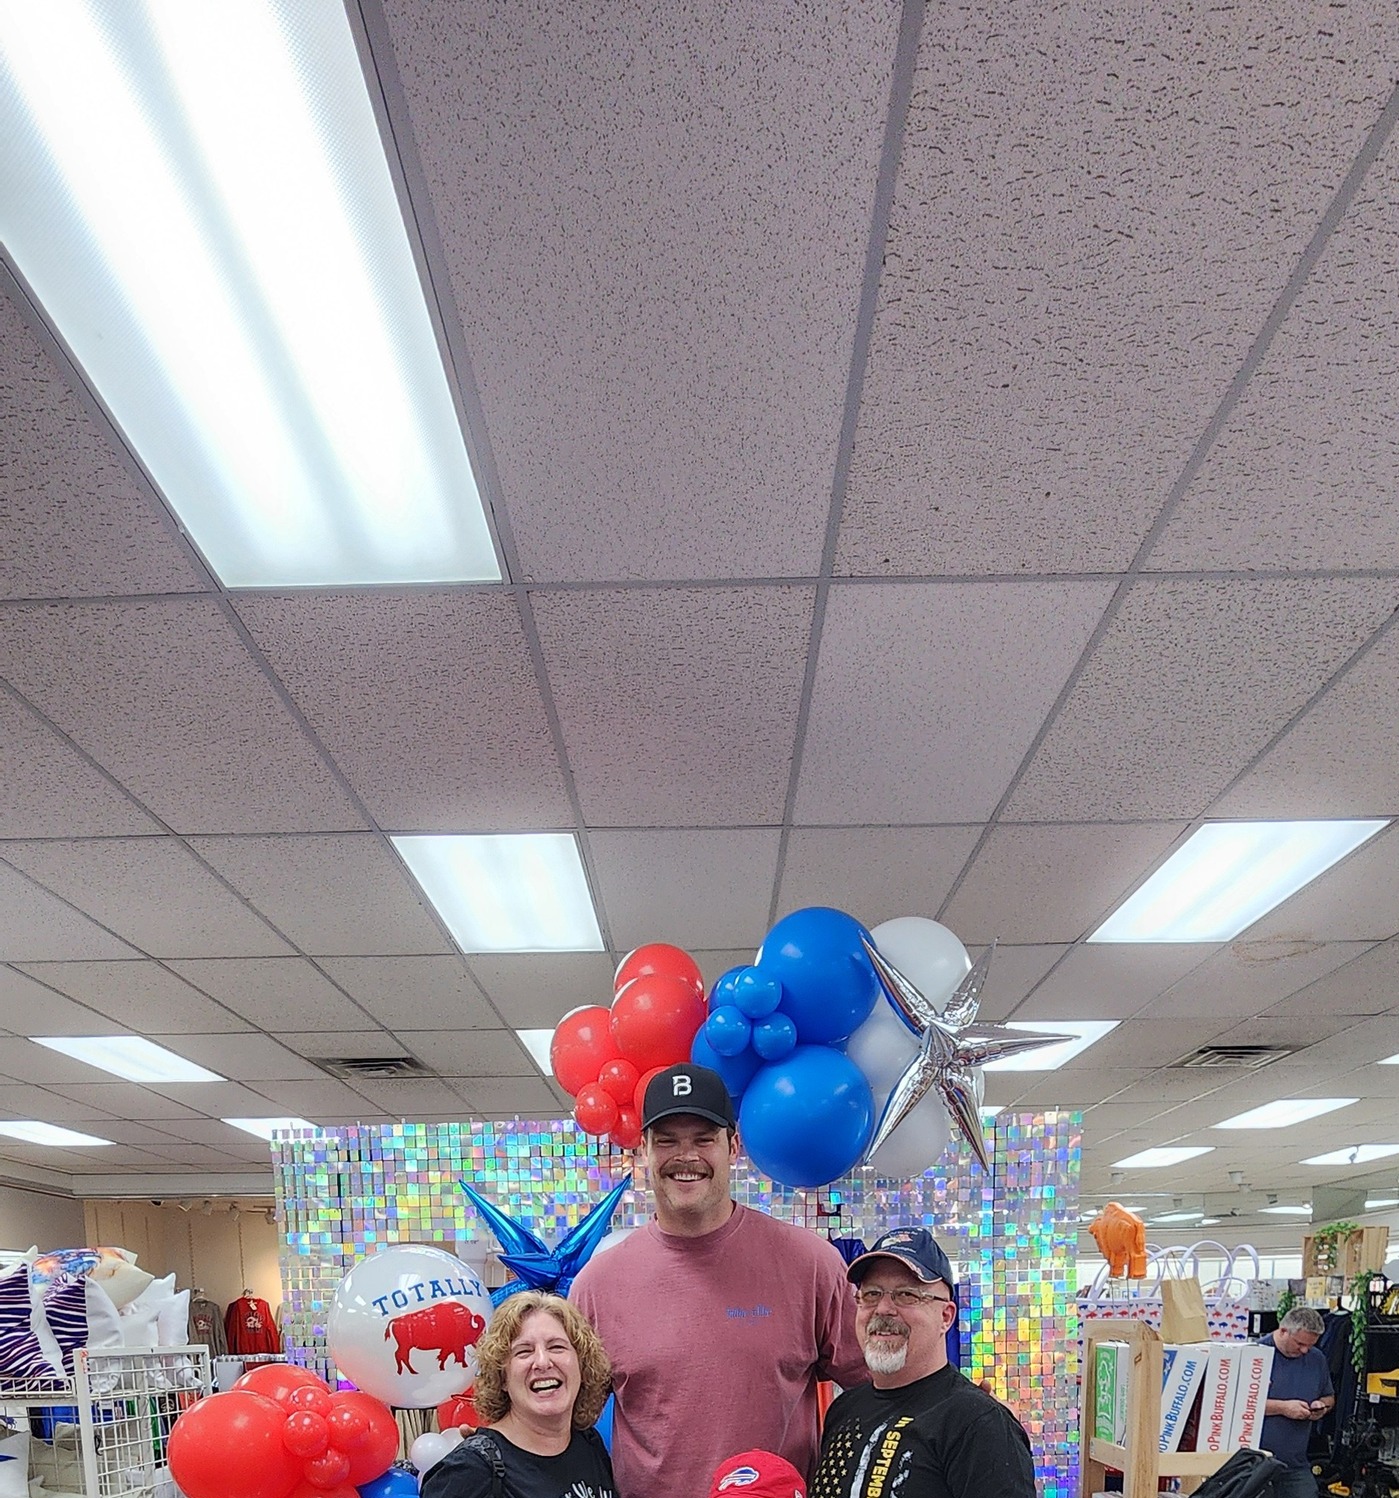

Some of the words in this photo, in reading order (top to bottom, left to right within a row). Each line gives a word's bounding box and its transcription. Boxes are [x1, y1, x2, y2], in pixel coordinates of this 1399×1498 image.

[672, 1074, 692, 1096] B
[372, 1278, 482, 1316] TOTALLY
[1159, 1360, 1197, 1453] OPINKBUFFALO.COM
[1207, 1358, 1231, 1452] OPINKBUFFALO.COM
